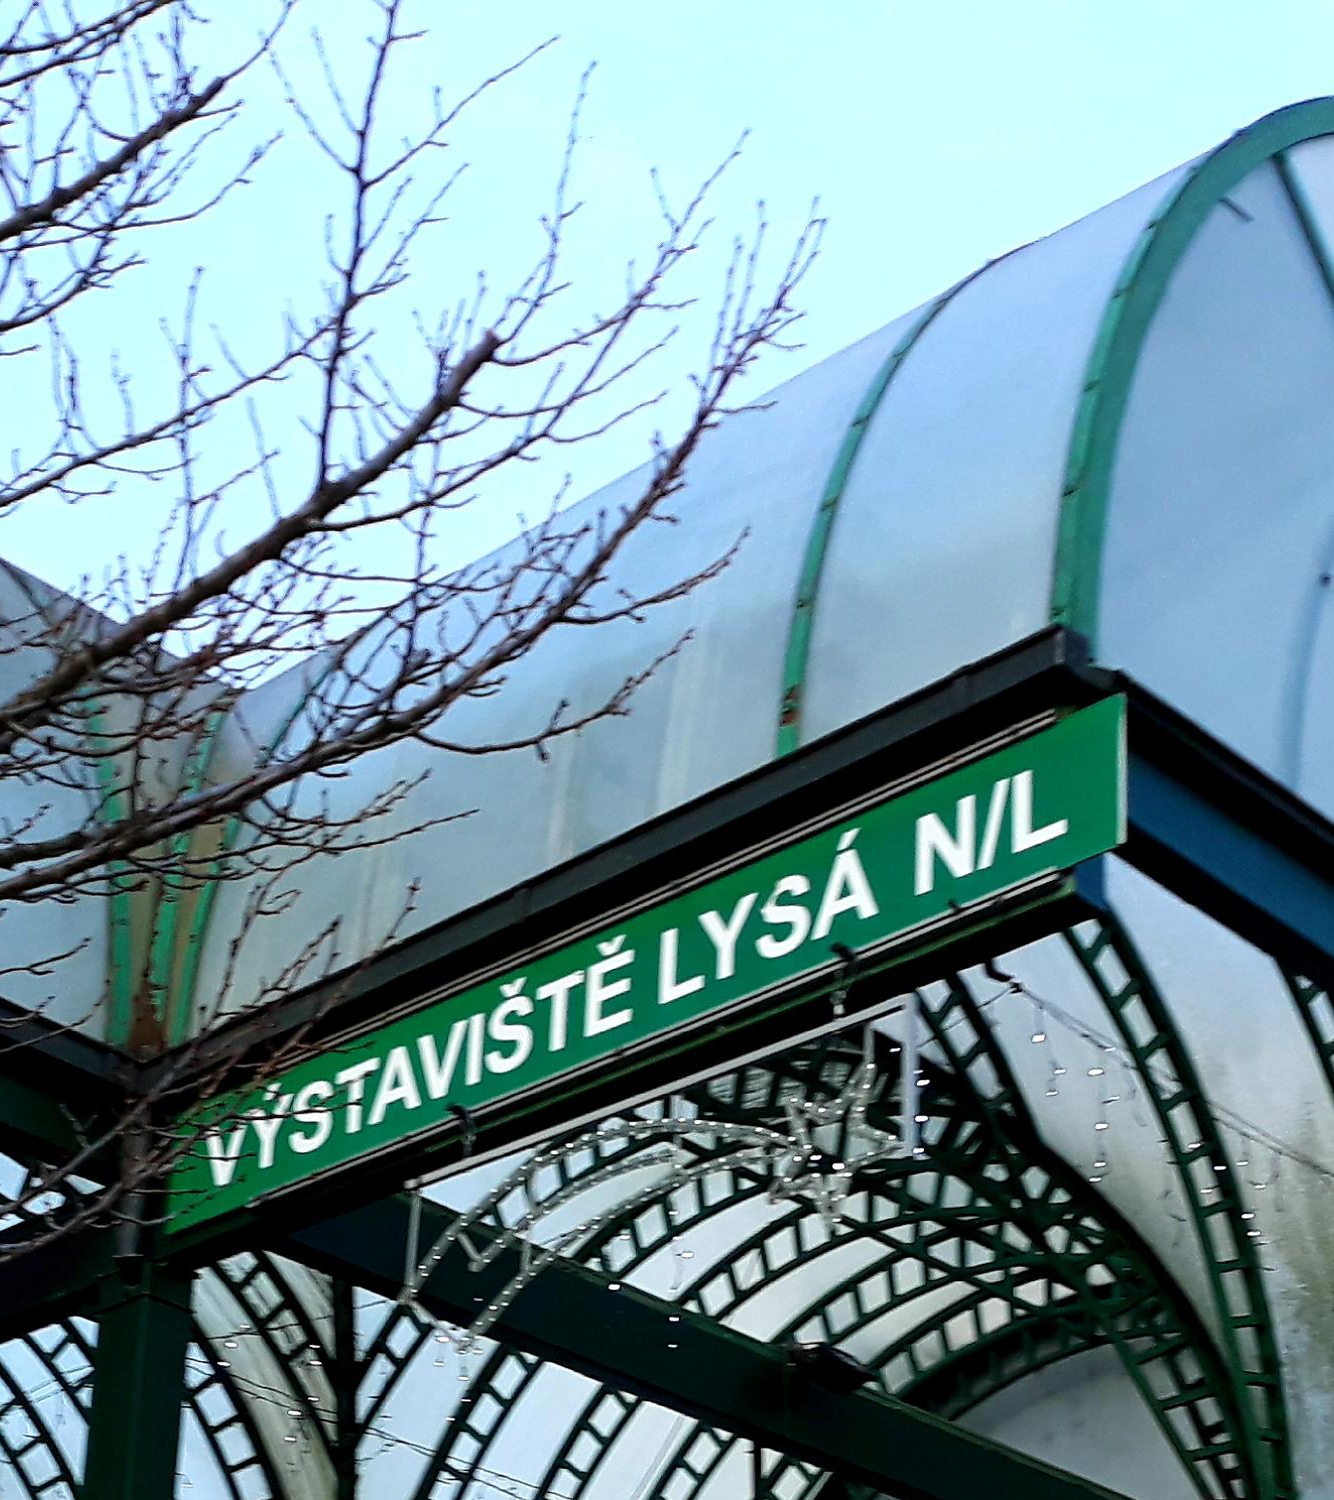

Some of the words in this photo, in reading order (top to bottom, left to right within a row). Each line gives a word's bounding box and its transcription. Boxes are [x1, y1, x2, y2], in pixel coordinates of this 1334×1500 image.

[205, 934, 636, 1187] VÝSTAVIŠTĚ
[657, 827, 880, 1004] LYSÁ
[913, 769, 1068, 896] N/L
